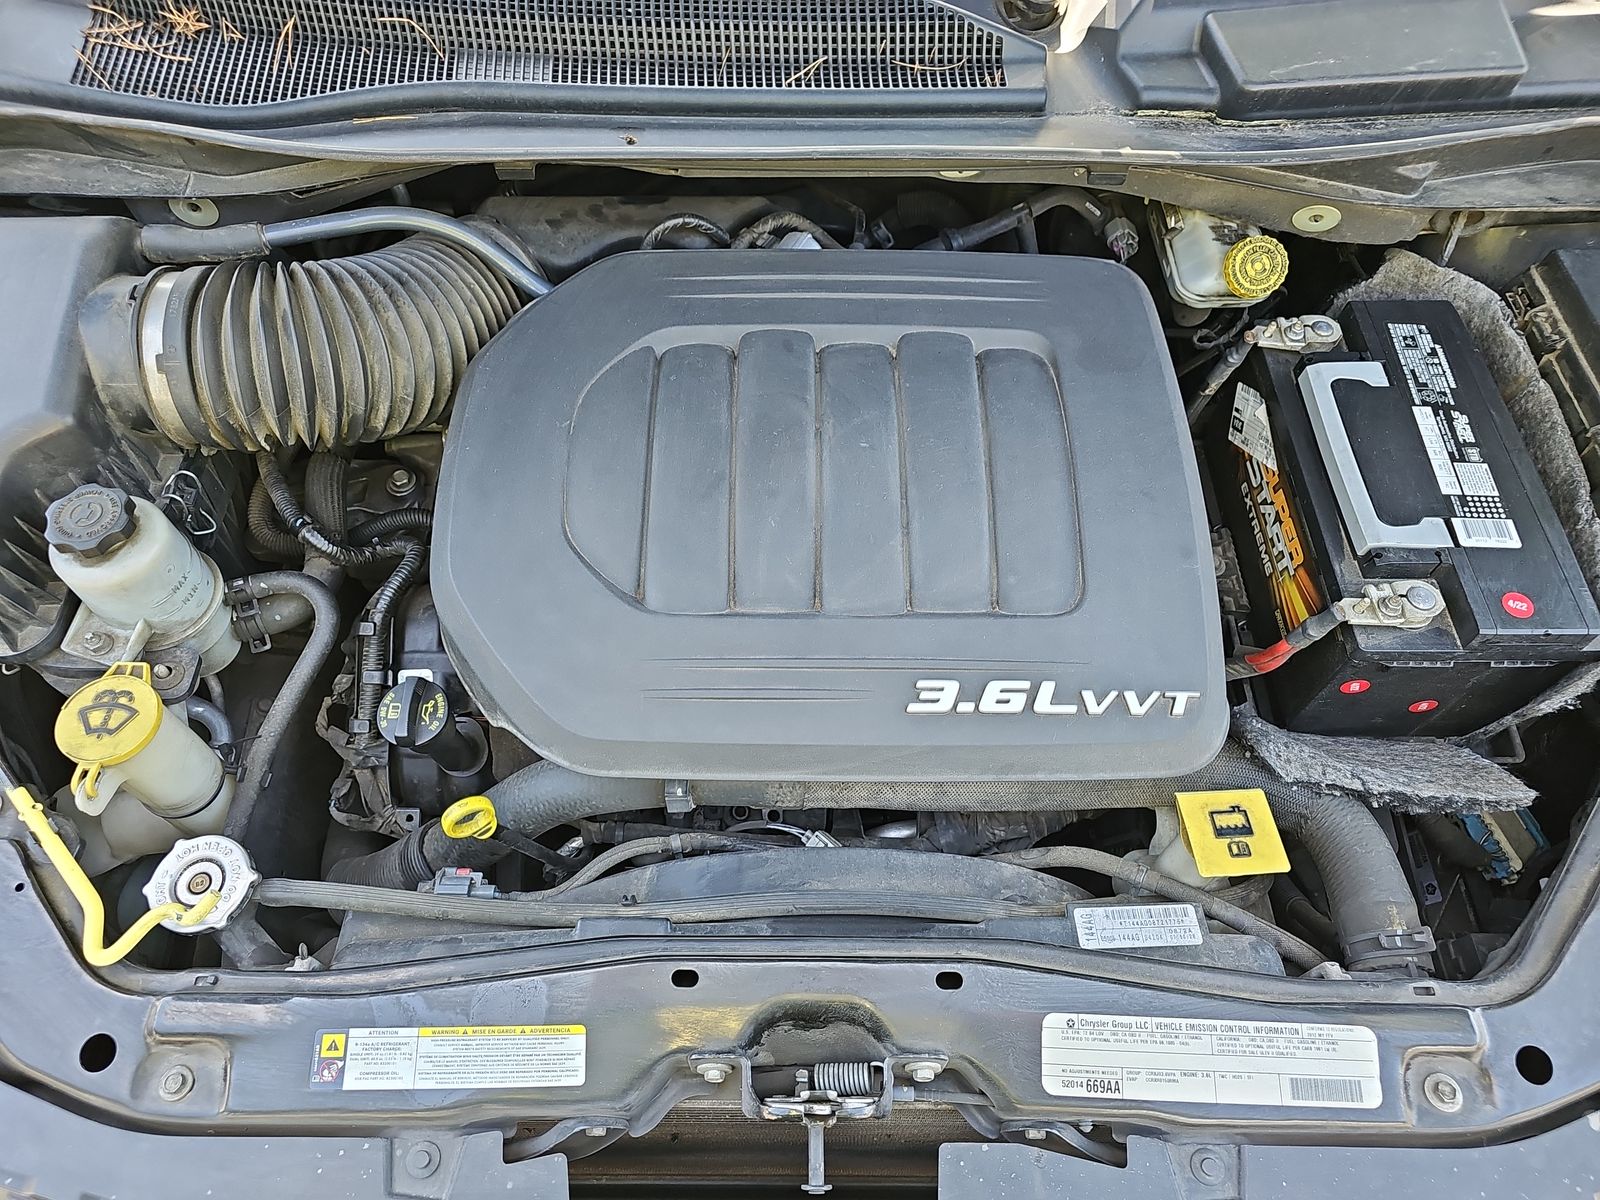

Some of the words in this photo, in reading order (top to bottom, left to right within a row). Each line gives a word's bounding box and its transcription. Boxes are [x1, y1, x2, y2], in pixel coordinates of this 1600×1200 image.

[1246, 457, 1294, 576] START
[1241, 482, 1273, 577] EXTREME
[1508, 600, 1528, 611] 4/22
[435, 693, 444, 718] ENGINE
[906, 680, 1078, 715] 3.6L
[1081, 689, 1200, 717] VVT
[428, 721, 439, 731] OIL
[1080, 1019, 1110, 1029] Chrysler
[1111, 1020, 1133, 1030] Group
[1135, 1021, 1148, 1029] LLC
[1155, 1022, 1183, 1031] VEHICLE
[1185, 1023, 1218, 1032] EMISSION
[1220, 1024, 1250, 1034] CONTROL
[1253, 1026, 1300, 1036] INFORMATION
[1062, 1079, 1084, 1089] 52014
[1086, 1079, 1121, 1094] 669AA
